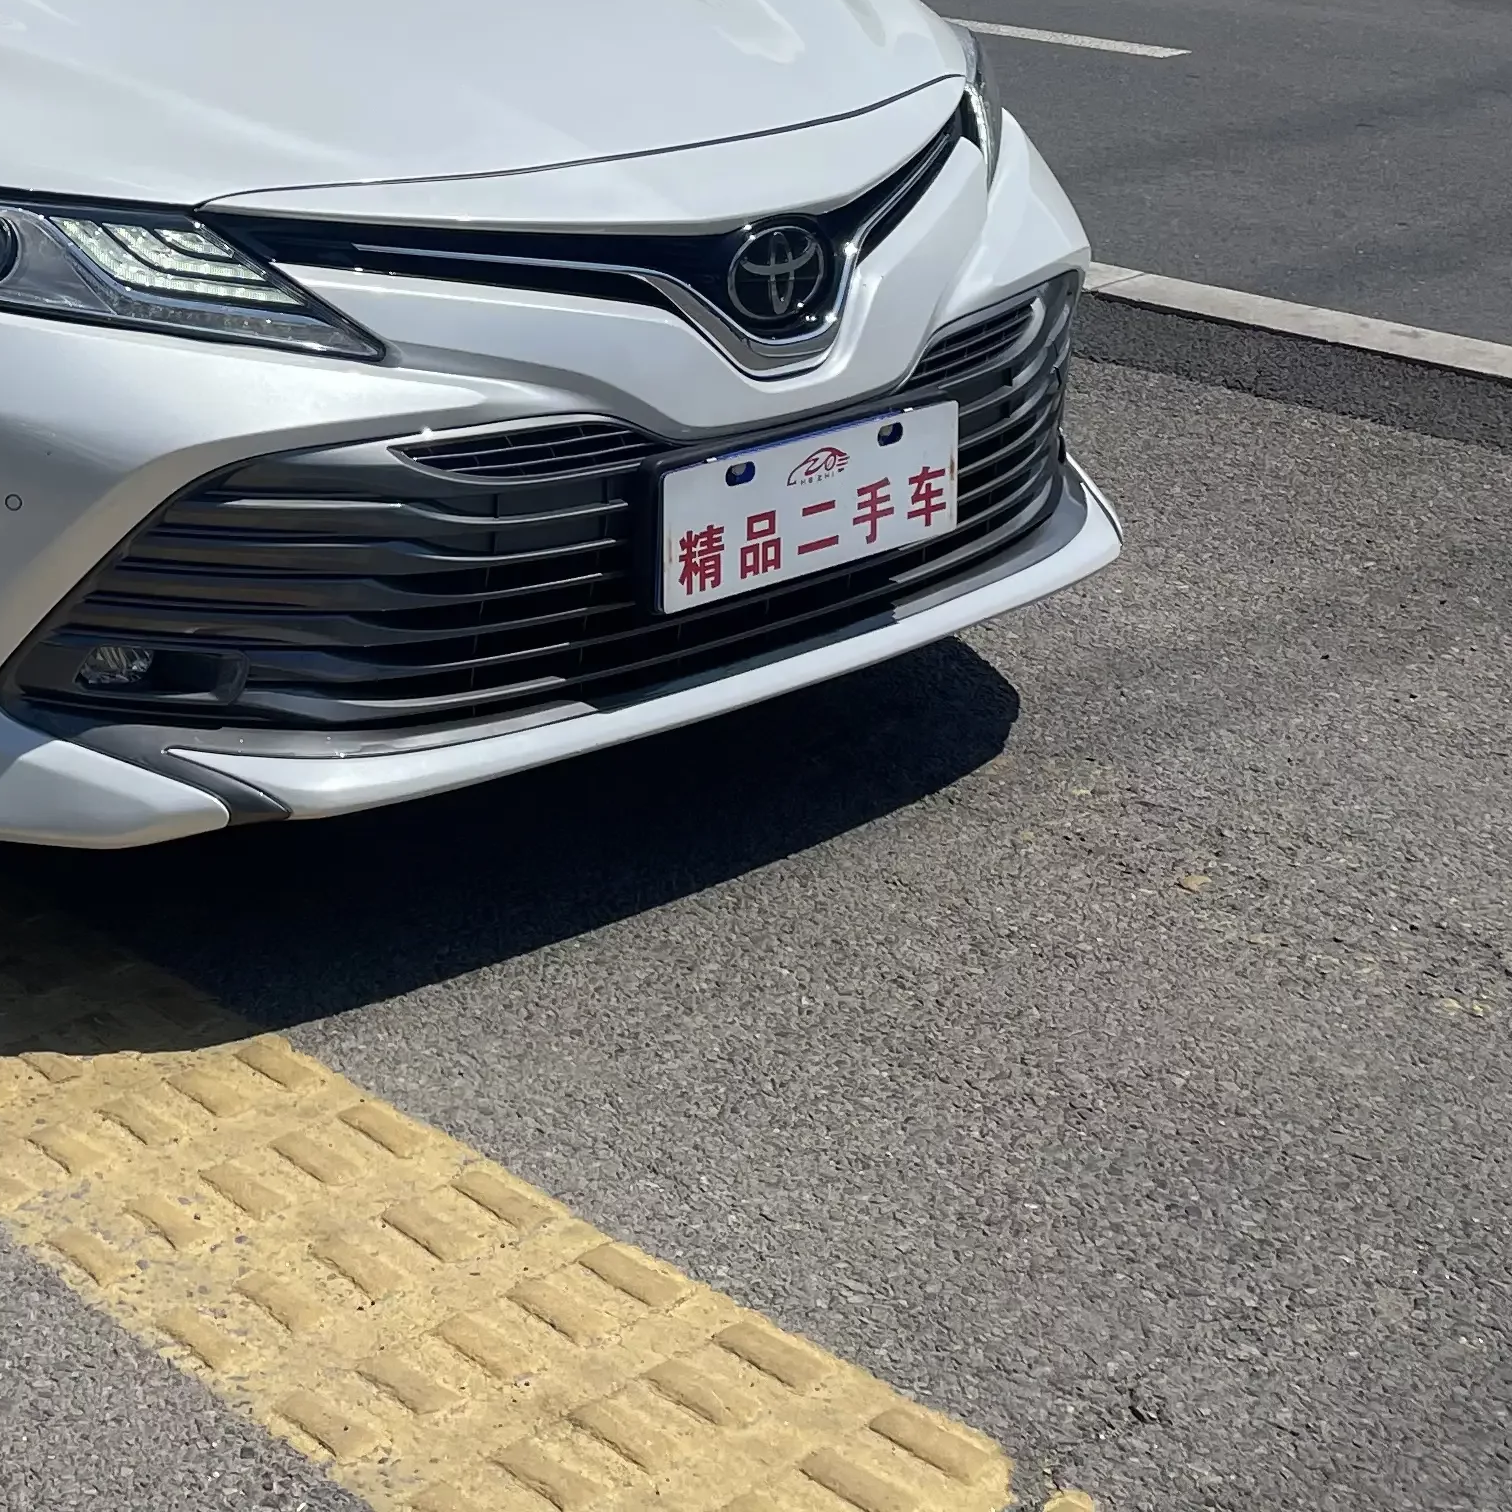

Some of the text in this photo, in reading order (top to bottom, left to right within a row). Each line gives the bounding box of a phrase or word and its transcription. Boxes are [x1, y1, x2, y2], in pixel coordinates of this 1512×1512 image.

[678, 466, 947, 596] 精品二手车
